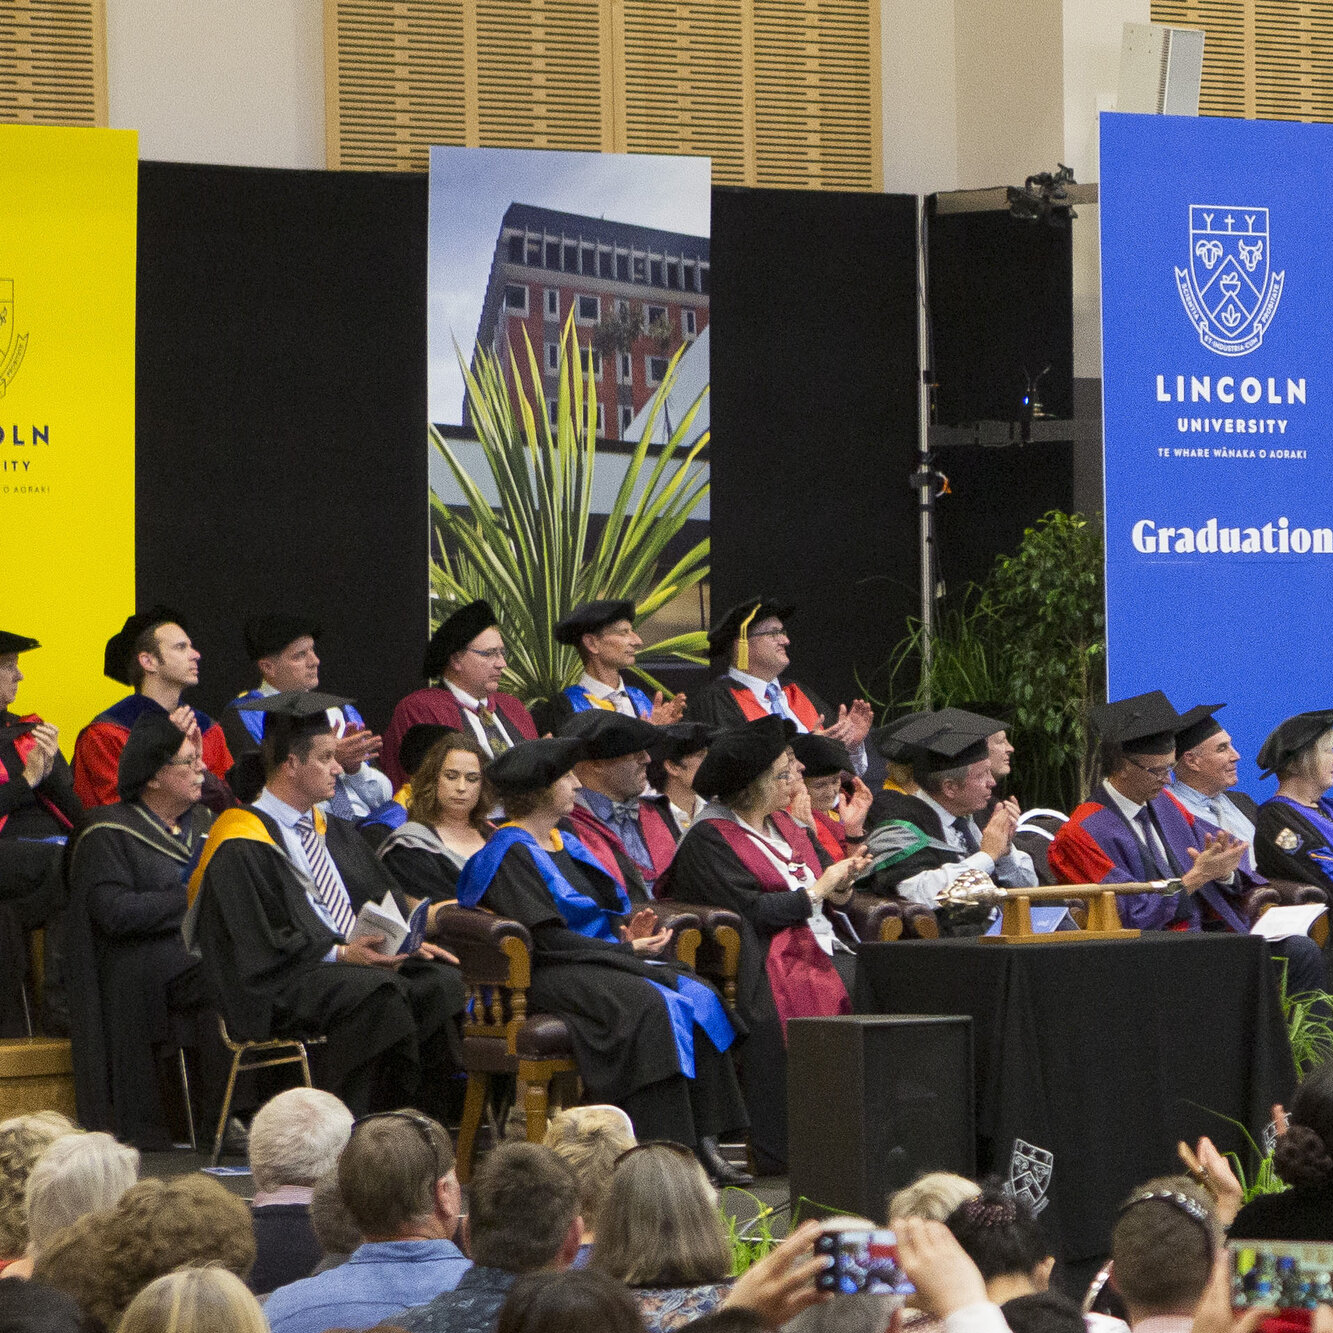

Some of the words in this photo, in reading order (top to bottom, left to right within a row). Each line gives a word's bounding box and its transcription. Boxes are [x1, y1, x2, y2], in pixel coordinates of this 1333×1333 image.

[1156, 374, 1306, 405] LINCOLN
[1177, 418, 1288, 434] UNIVERSITY
[1158, 448, 1170, 457] TE
[1174, 448, 1210, 458] WHARE
[1258, 449, 1267, 459] O
[1269, 449, 1307, 459] AORAKI
